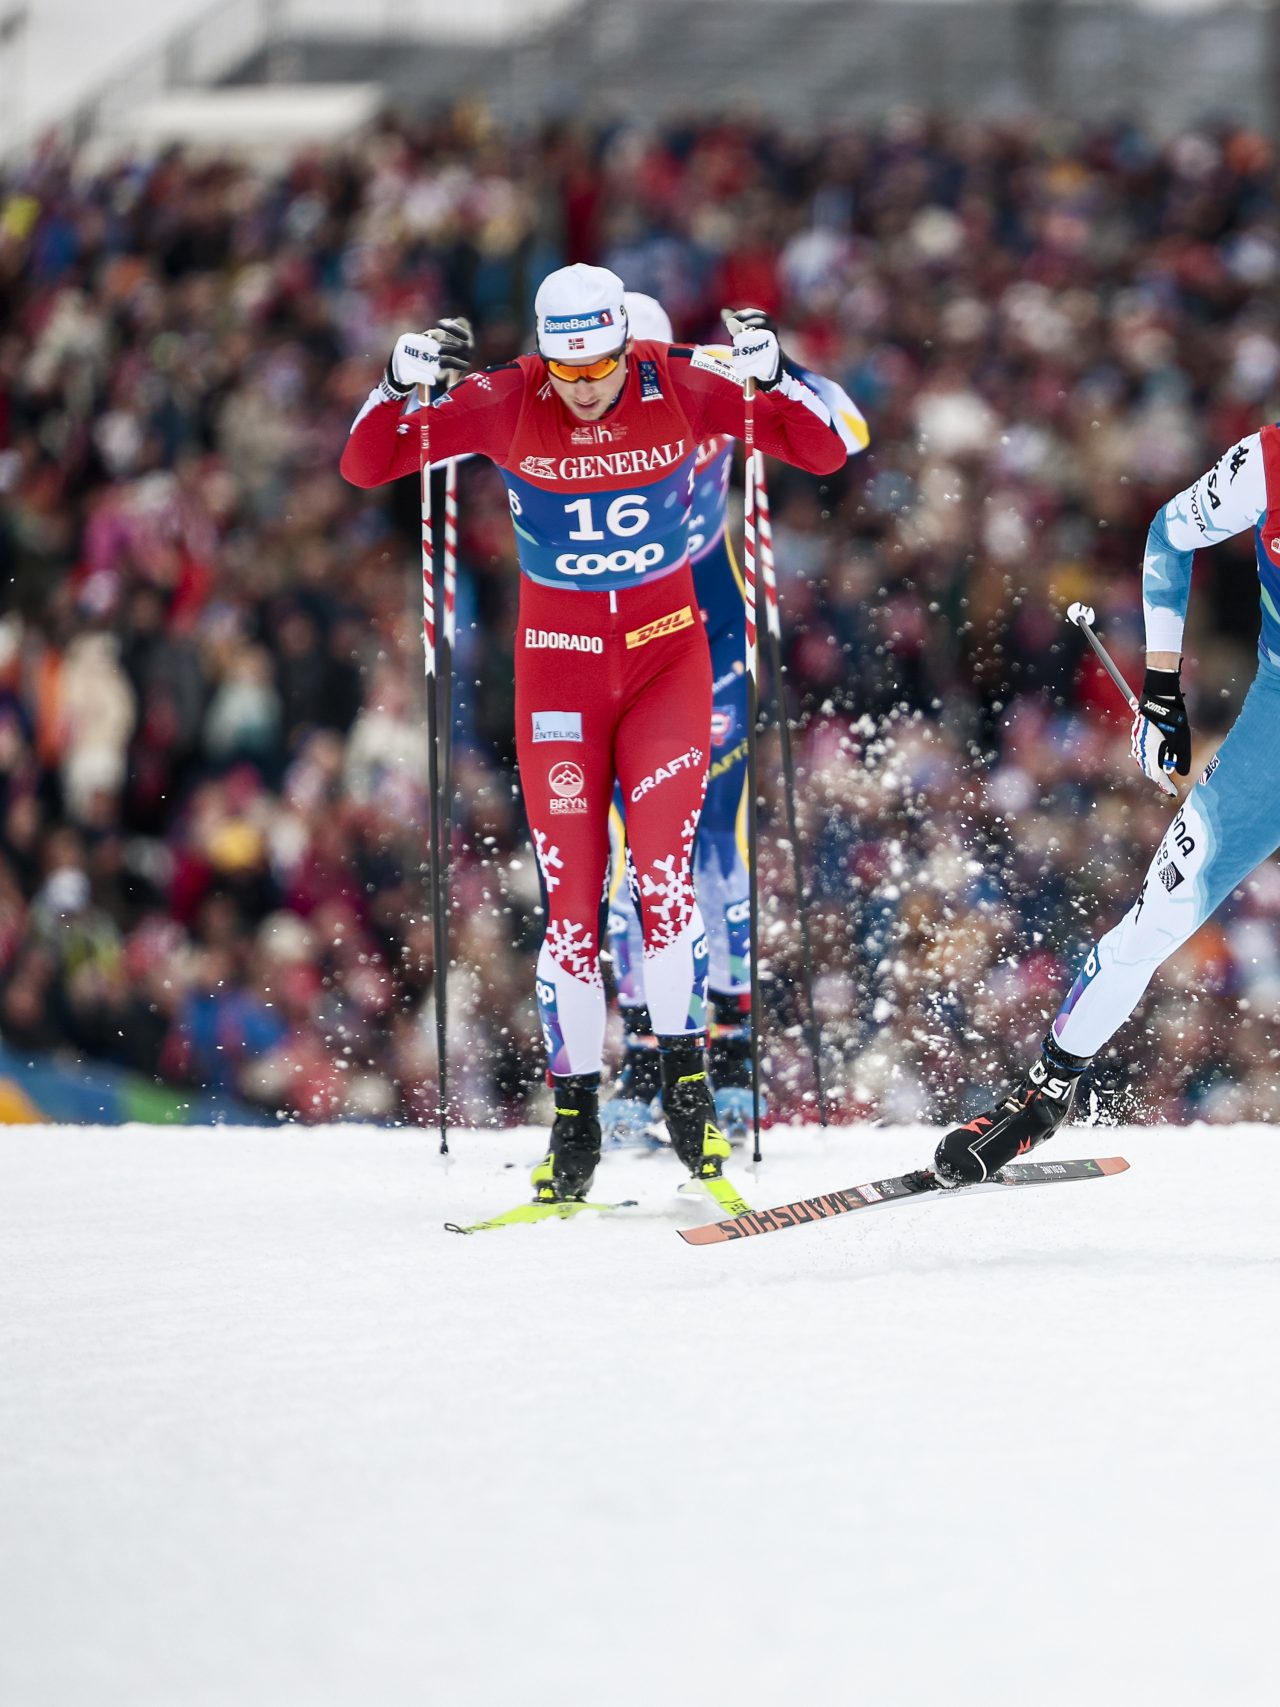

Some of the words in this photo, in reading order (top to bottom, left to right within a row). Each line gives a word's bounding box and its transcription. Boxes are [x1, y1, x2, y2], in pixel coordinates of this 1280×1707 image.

[545, 315, 600, 332] SpareBank
[559, 439, 686, 480] GENERALI
[564, 494, 650, 541] 16
[555, 543, 665, 575] coop
[525, 628, 604, 654] ELDORADO
[637, 613, 687, 642] DHL
[534, 731, 581, 741] ENTELIOS
[631, 752, 693, 803] CRAFT
[550, 798, 588, 809] BRYN
